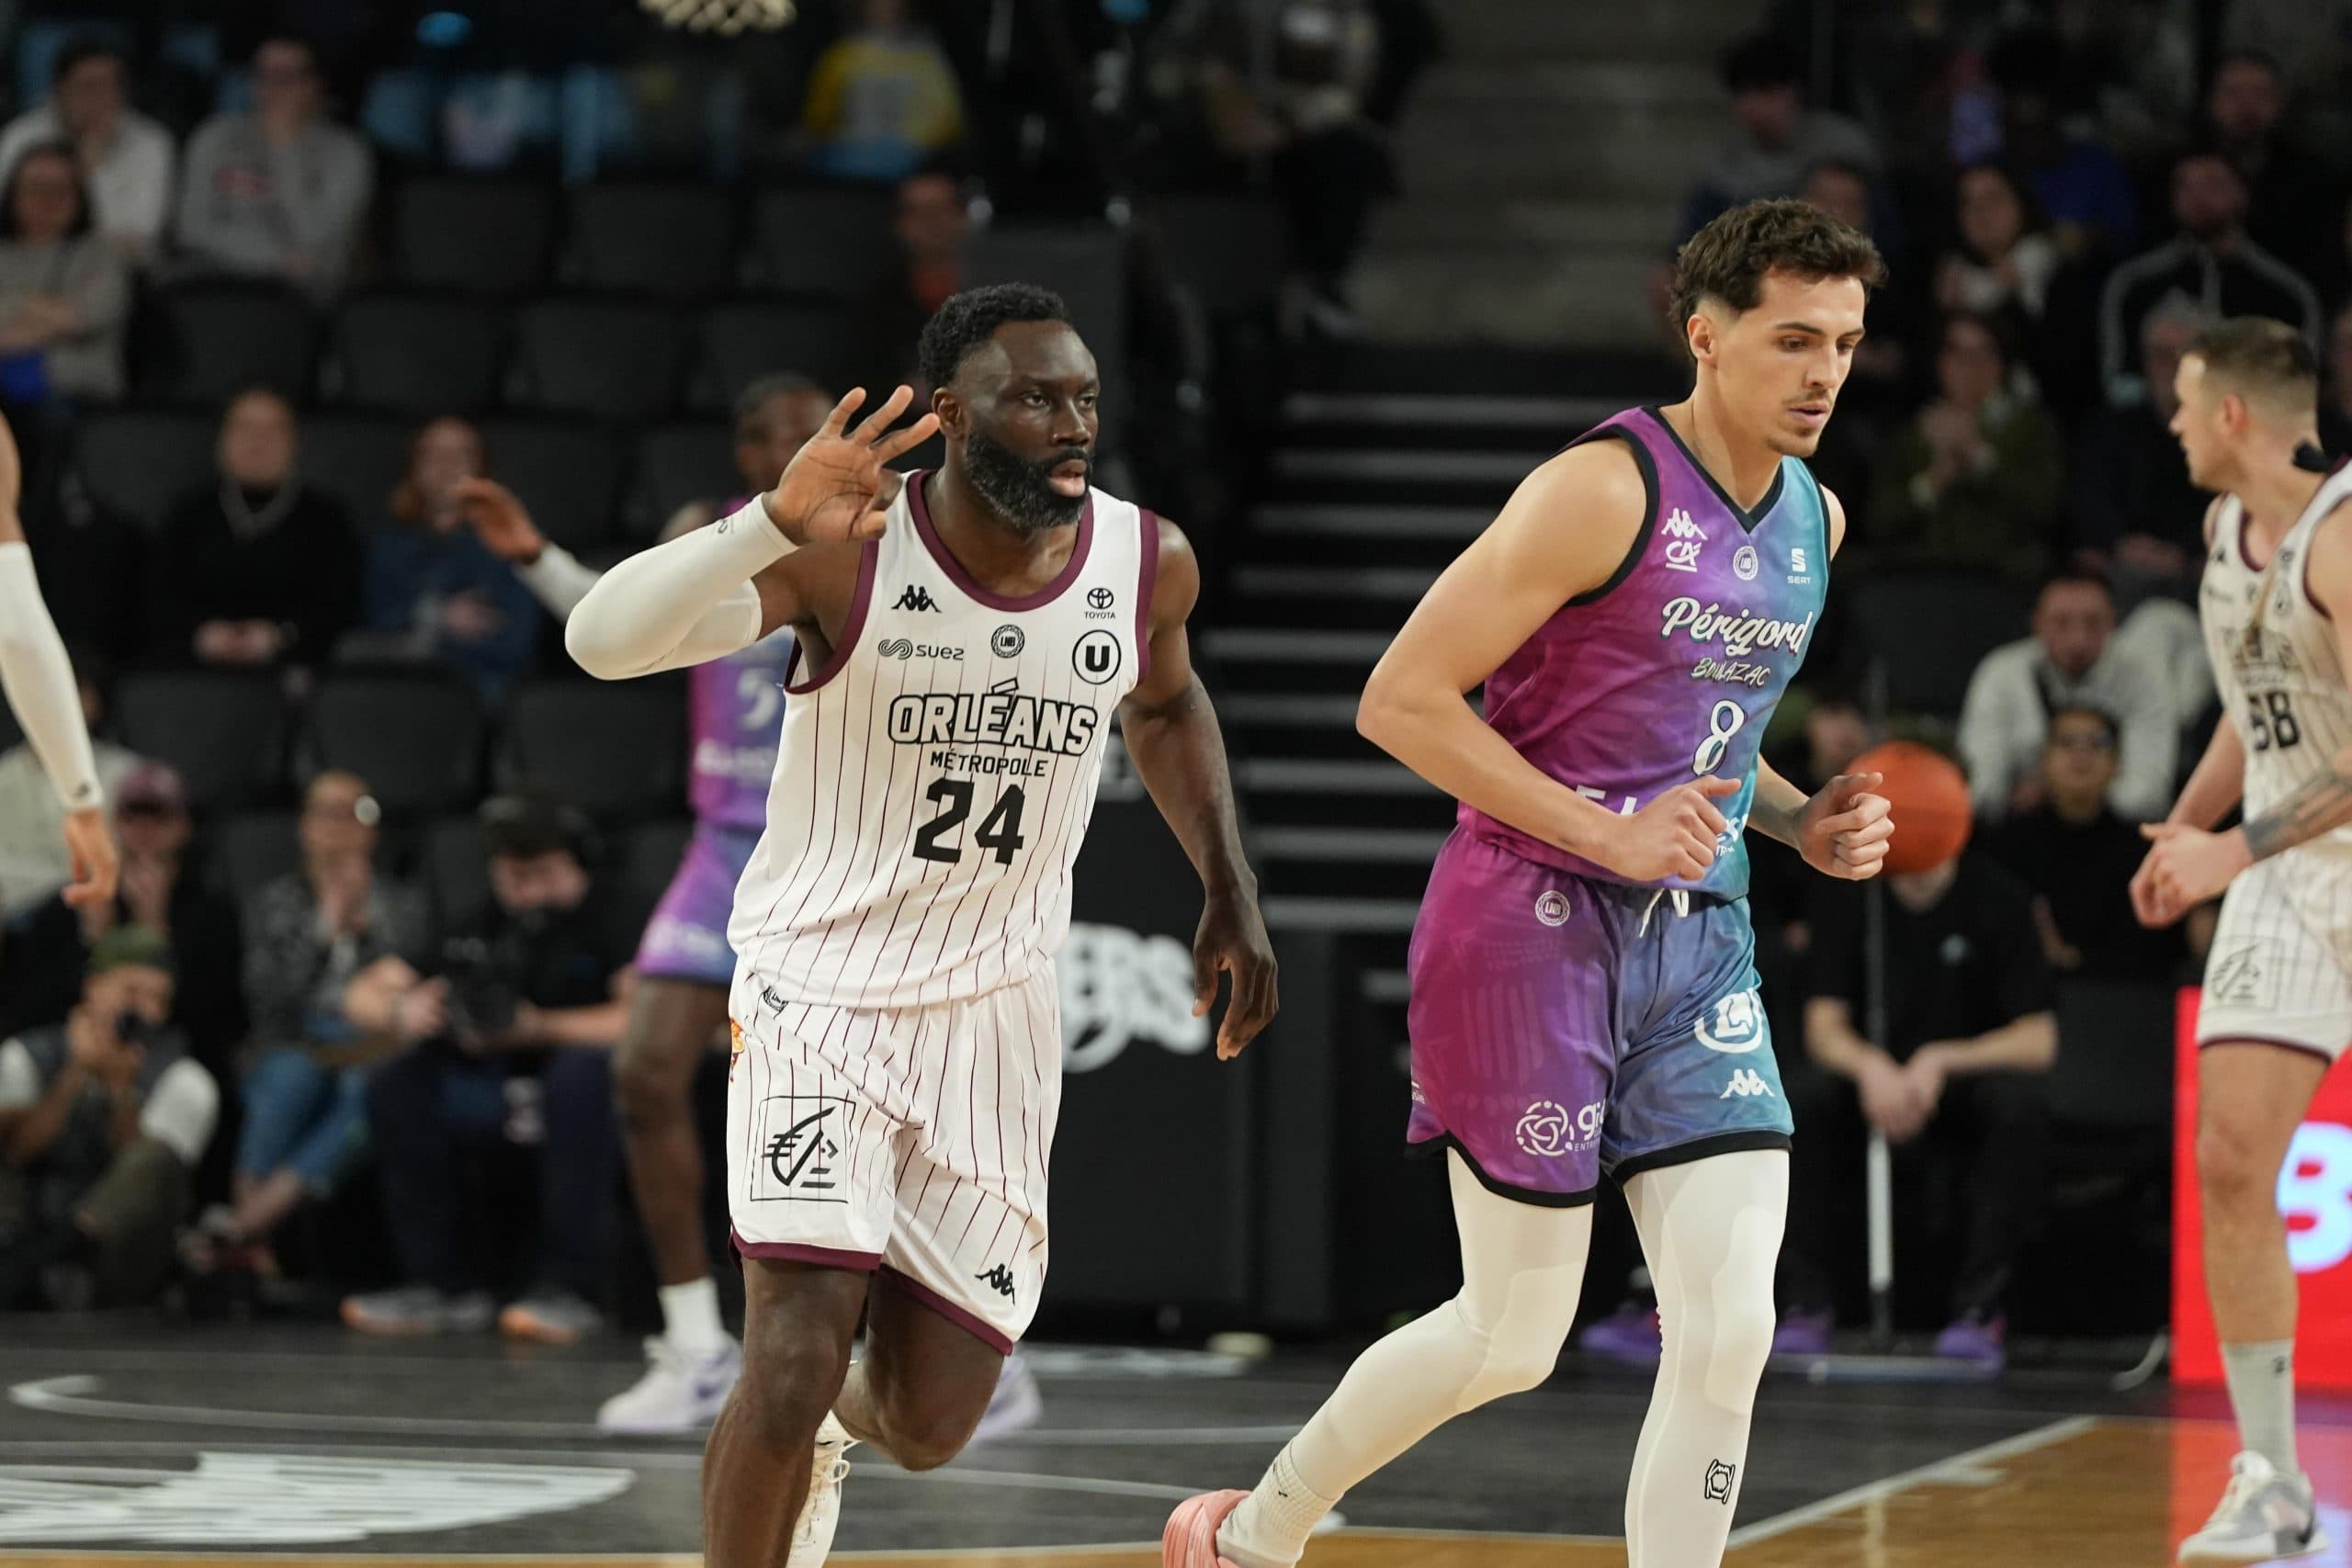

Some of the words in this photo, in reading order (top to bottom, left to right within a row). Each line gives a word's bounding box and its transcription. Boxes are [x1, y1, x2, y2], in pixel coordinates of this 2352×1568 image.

[1084, 611, 1115, 619] TOYOTA
[1661, 597, 1814, 657] Périgord
[1085, 645, 1110, 672] U
[888, 678, 1098, 756] ORLÉANS
[1692, 700, 1747, 776] 8
[930, 749, 1048, 777] MÉTROPOLE
[912, 777, 1026, 865] 24
